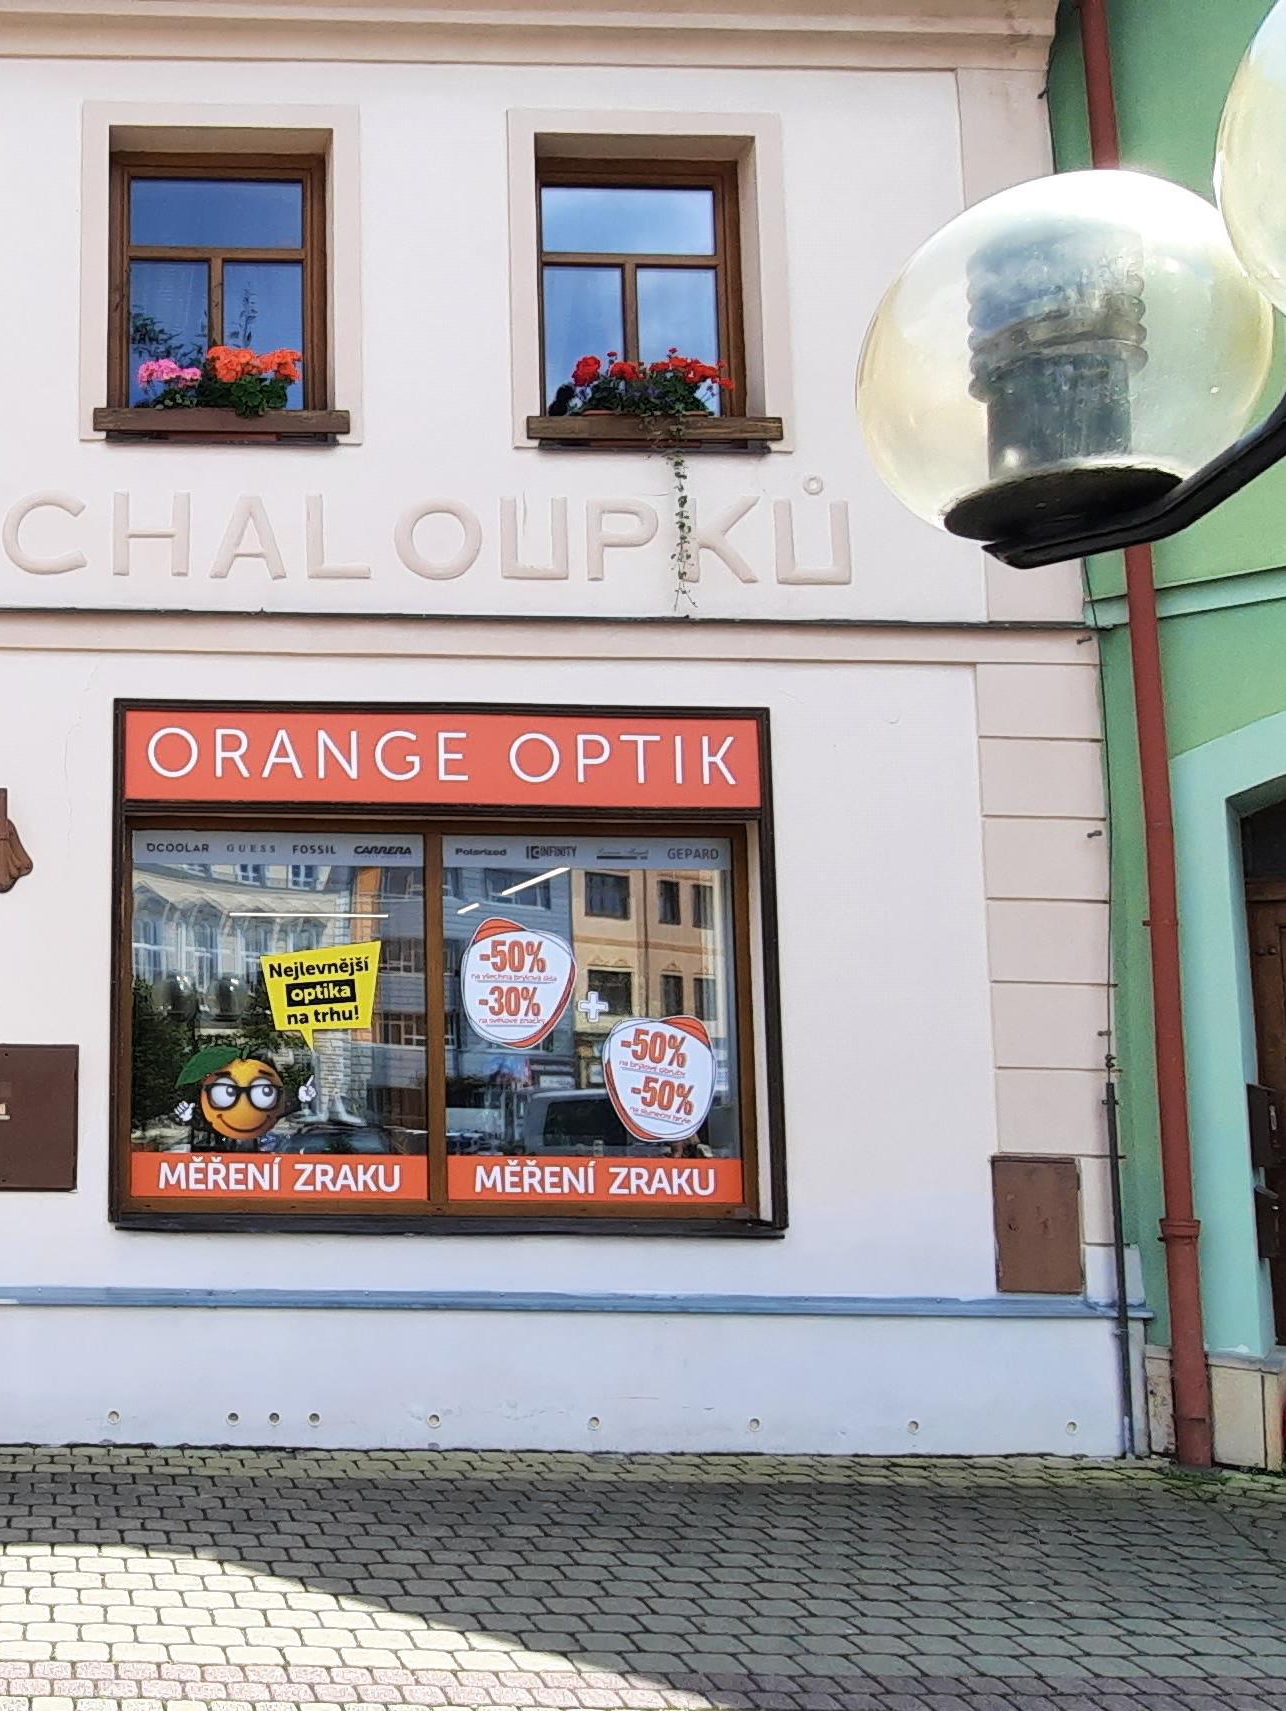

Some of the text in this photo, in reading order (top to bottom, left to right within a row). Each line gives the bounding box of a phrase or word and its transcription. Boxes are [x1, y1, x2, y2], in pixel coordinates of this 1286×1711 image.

[2, 474, 852, 585] CHALOUPKŮ
[146, 726, 738, 786] ORANGE OPTIK
[226, 843, 277, 854] GUESS
[292, 844, 337, 855] FOSSIL
[353, 845, 412, 856] CARRERA
[455, 847, 507, 857] Polarized
[667, 848, 719, 860] GEPARD
[268, 956, 370, 981] Nejlevnější
[479, 939, 547, 973] -50%
[290, 983, 352, 1004] optika
[478, 985, 542, 1017] -30%
[287, 1005, 360, 1025] na trhu!
[620, 1028, 688, 1069] -50%
[631, 1075, 694, 1116] -50%
[158, 1156, 402, 1193] MĚŘENÍ ZRAKU
[474, 1160, 716, 1196] MĚŘENÍ ZRAKU
